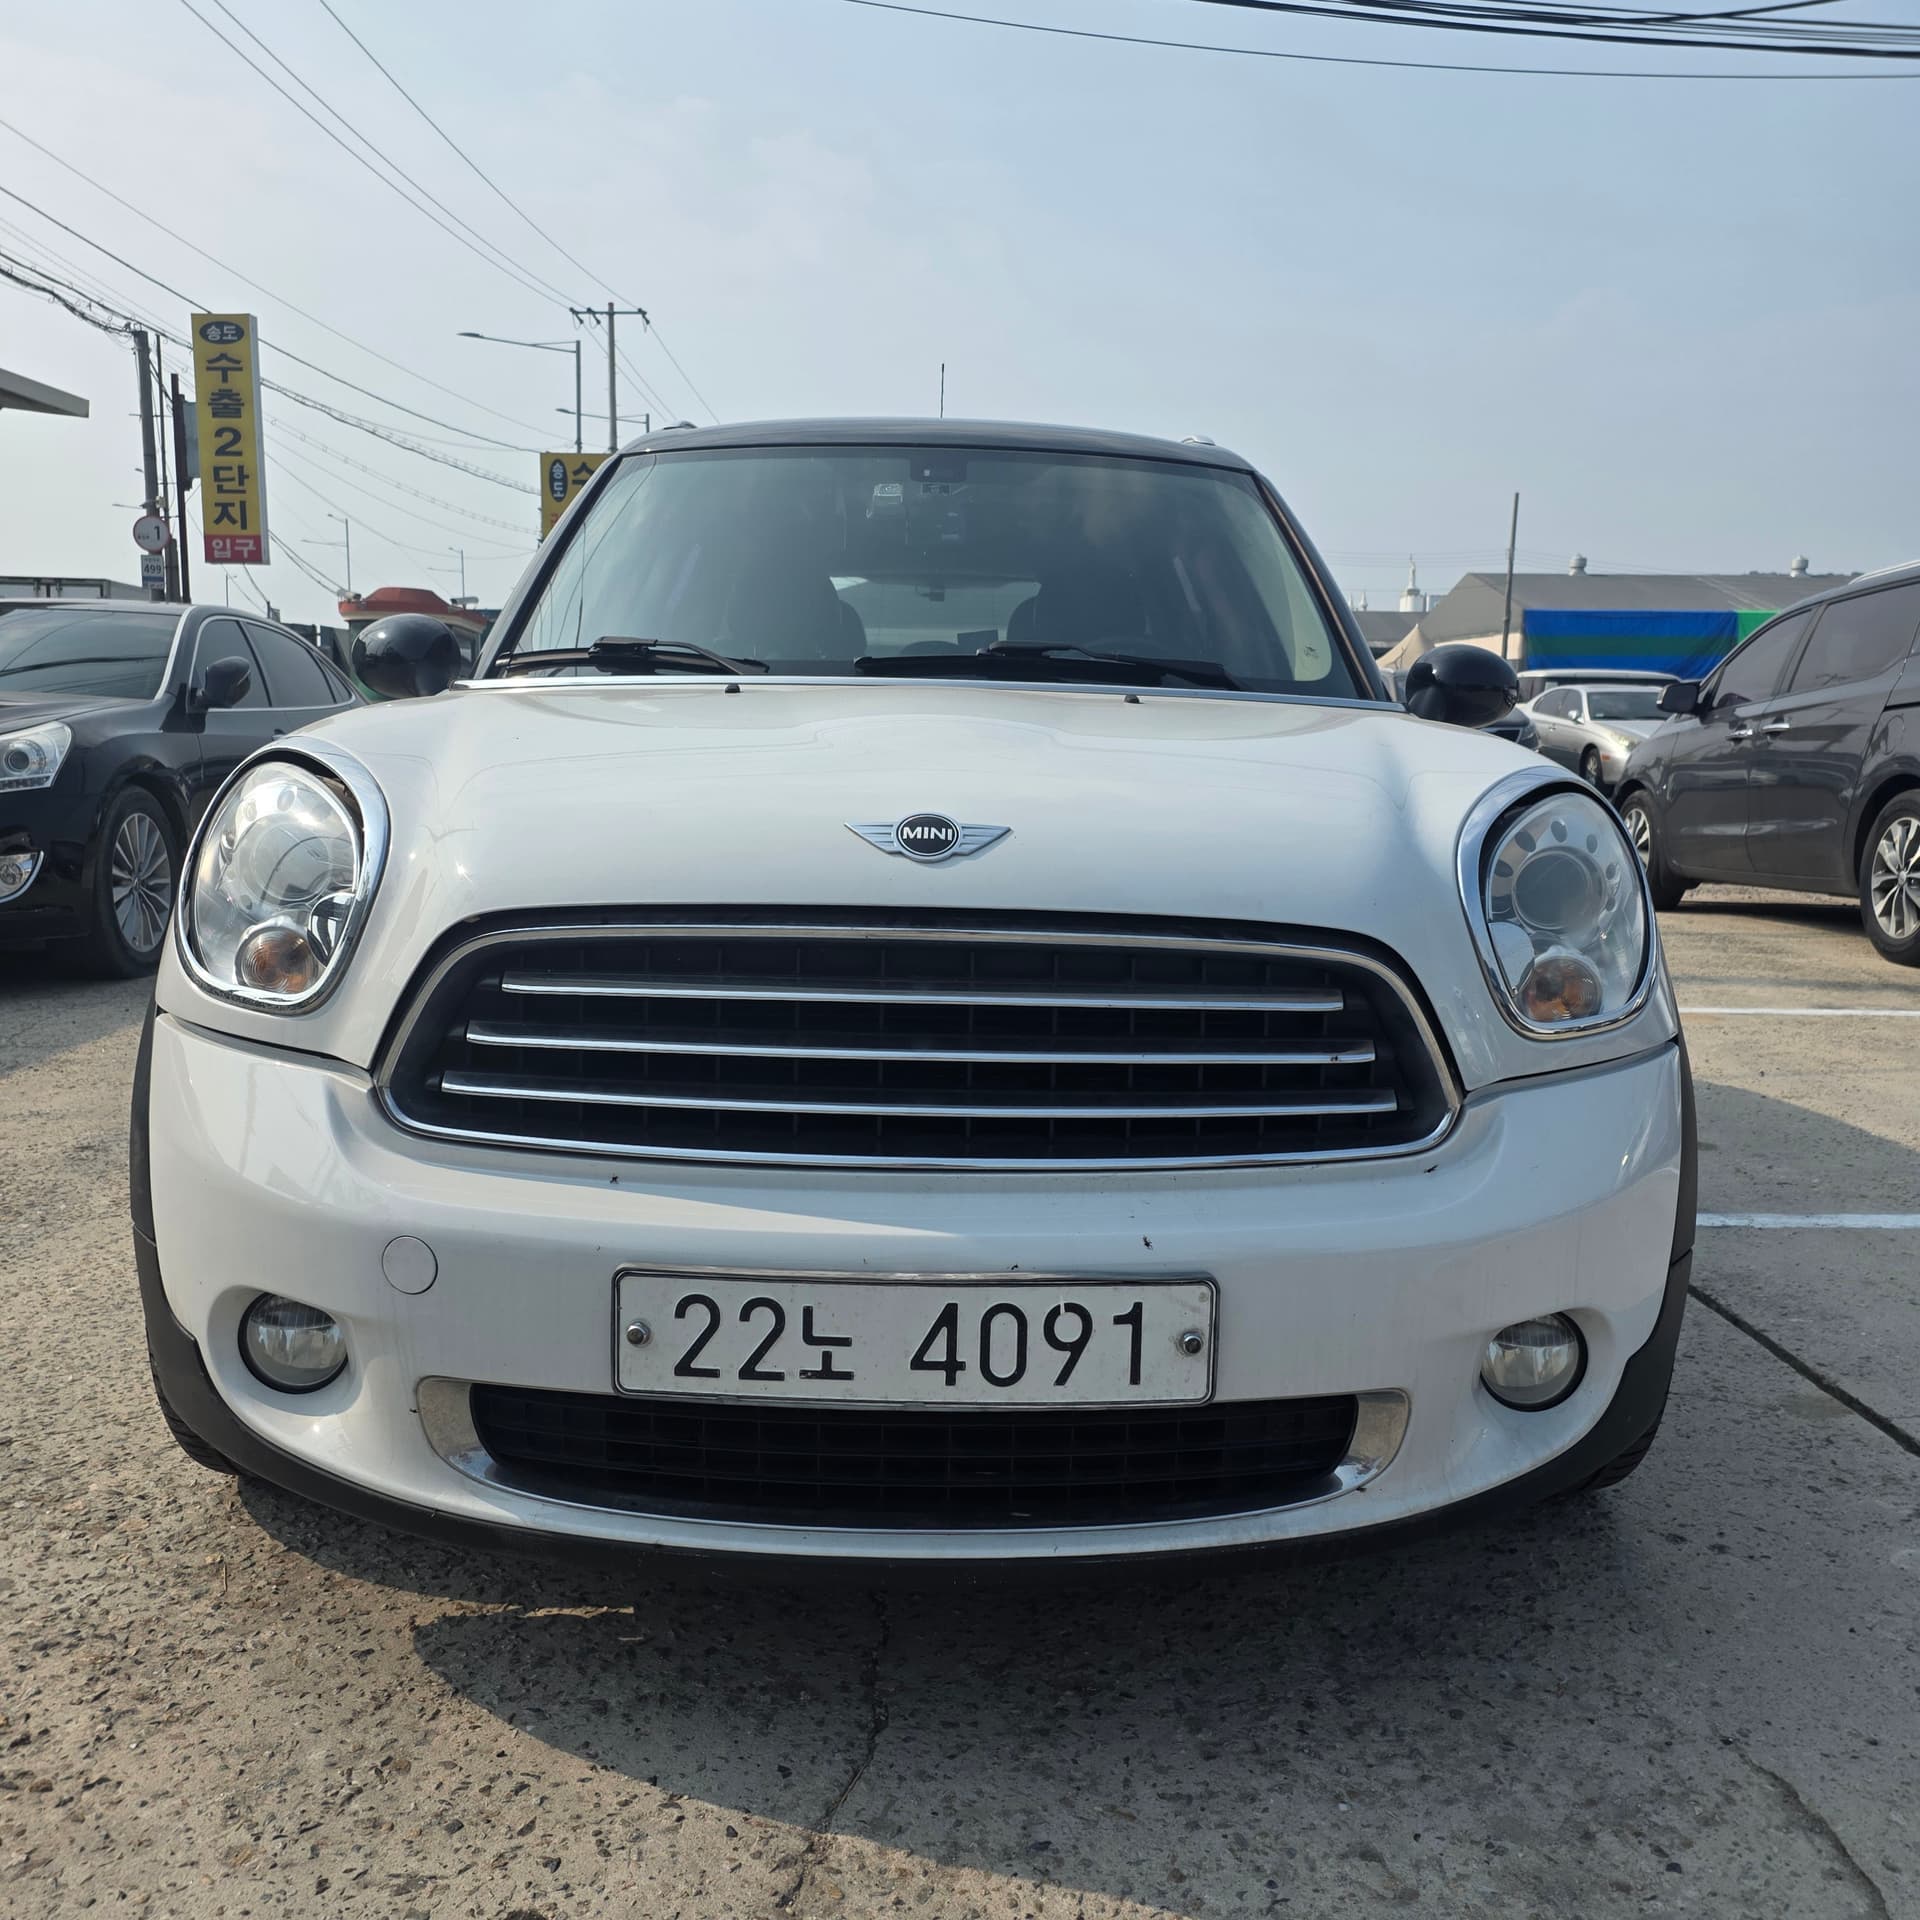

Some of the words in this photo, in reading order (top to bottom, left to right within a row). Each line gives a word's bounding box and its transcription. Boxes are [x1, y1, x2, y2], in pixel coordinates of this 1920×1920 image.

[205, 325, 239, 341] 송도
[206, 352, 250, 530] 수출2단지
[211, 538, 257, 559] 입구
[143, 563, 162, 575] 499
[902, 826, 953, 841] MINI
[673, 1293, 855, 1381] 22노
[910, 1301, 1144, 1387] 4091
